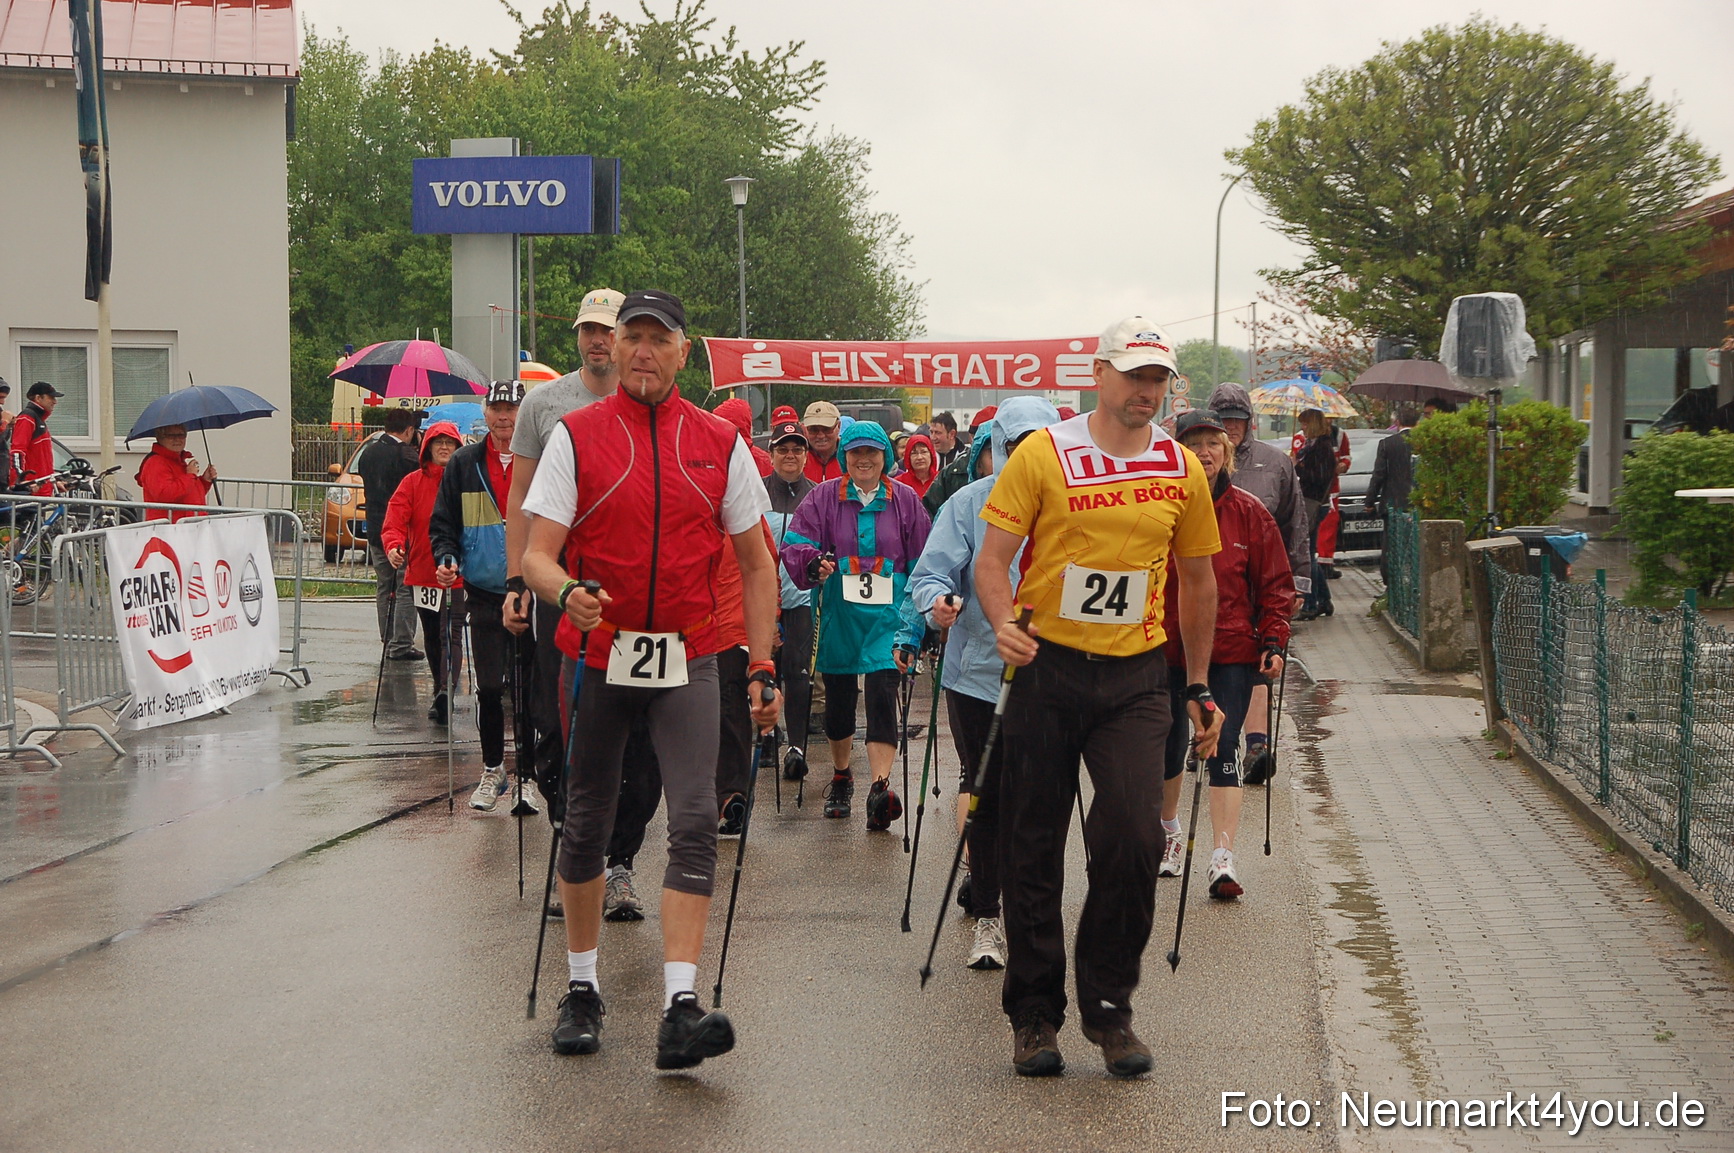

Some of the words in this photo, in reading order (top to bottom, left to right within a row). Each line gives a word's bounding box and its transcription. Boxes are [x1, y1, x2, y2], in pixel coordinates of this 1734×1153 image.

[429, 180, 567, 207] VOLVO
[1175, 380, 1187, 390] 60
[1068, 491, 1127, 513] MAX
[1134, 482, 1189, 504] BÖGL
[420, 586, 438, 608] 38
[859, 572, 873, 599] 3
[1080, 572, 1130, 617] 24
[630, 635, 668, 680] 21
